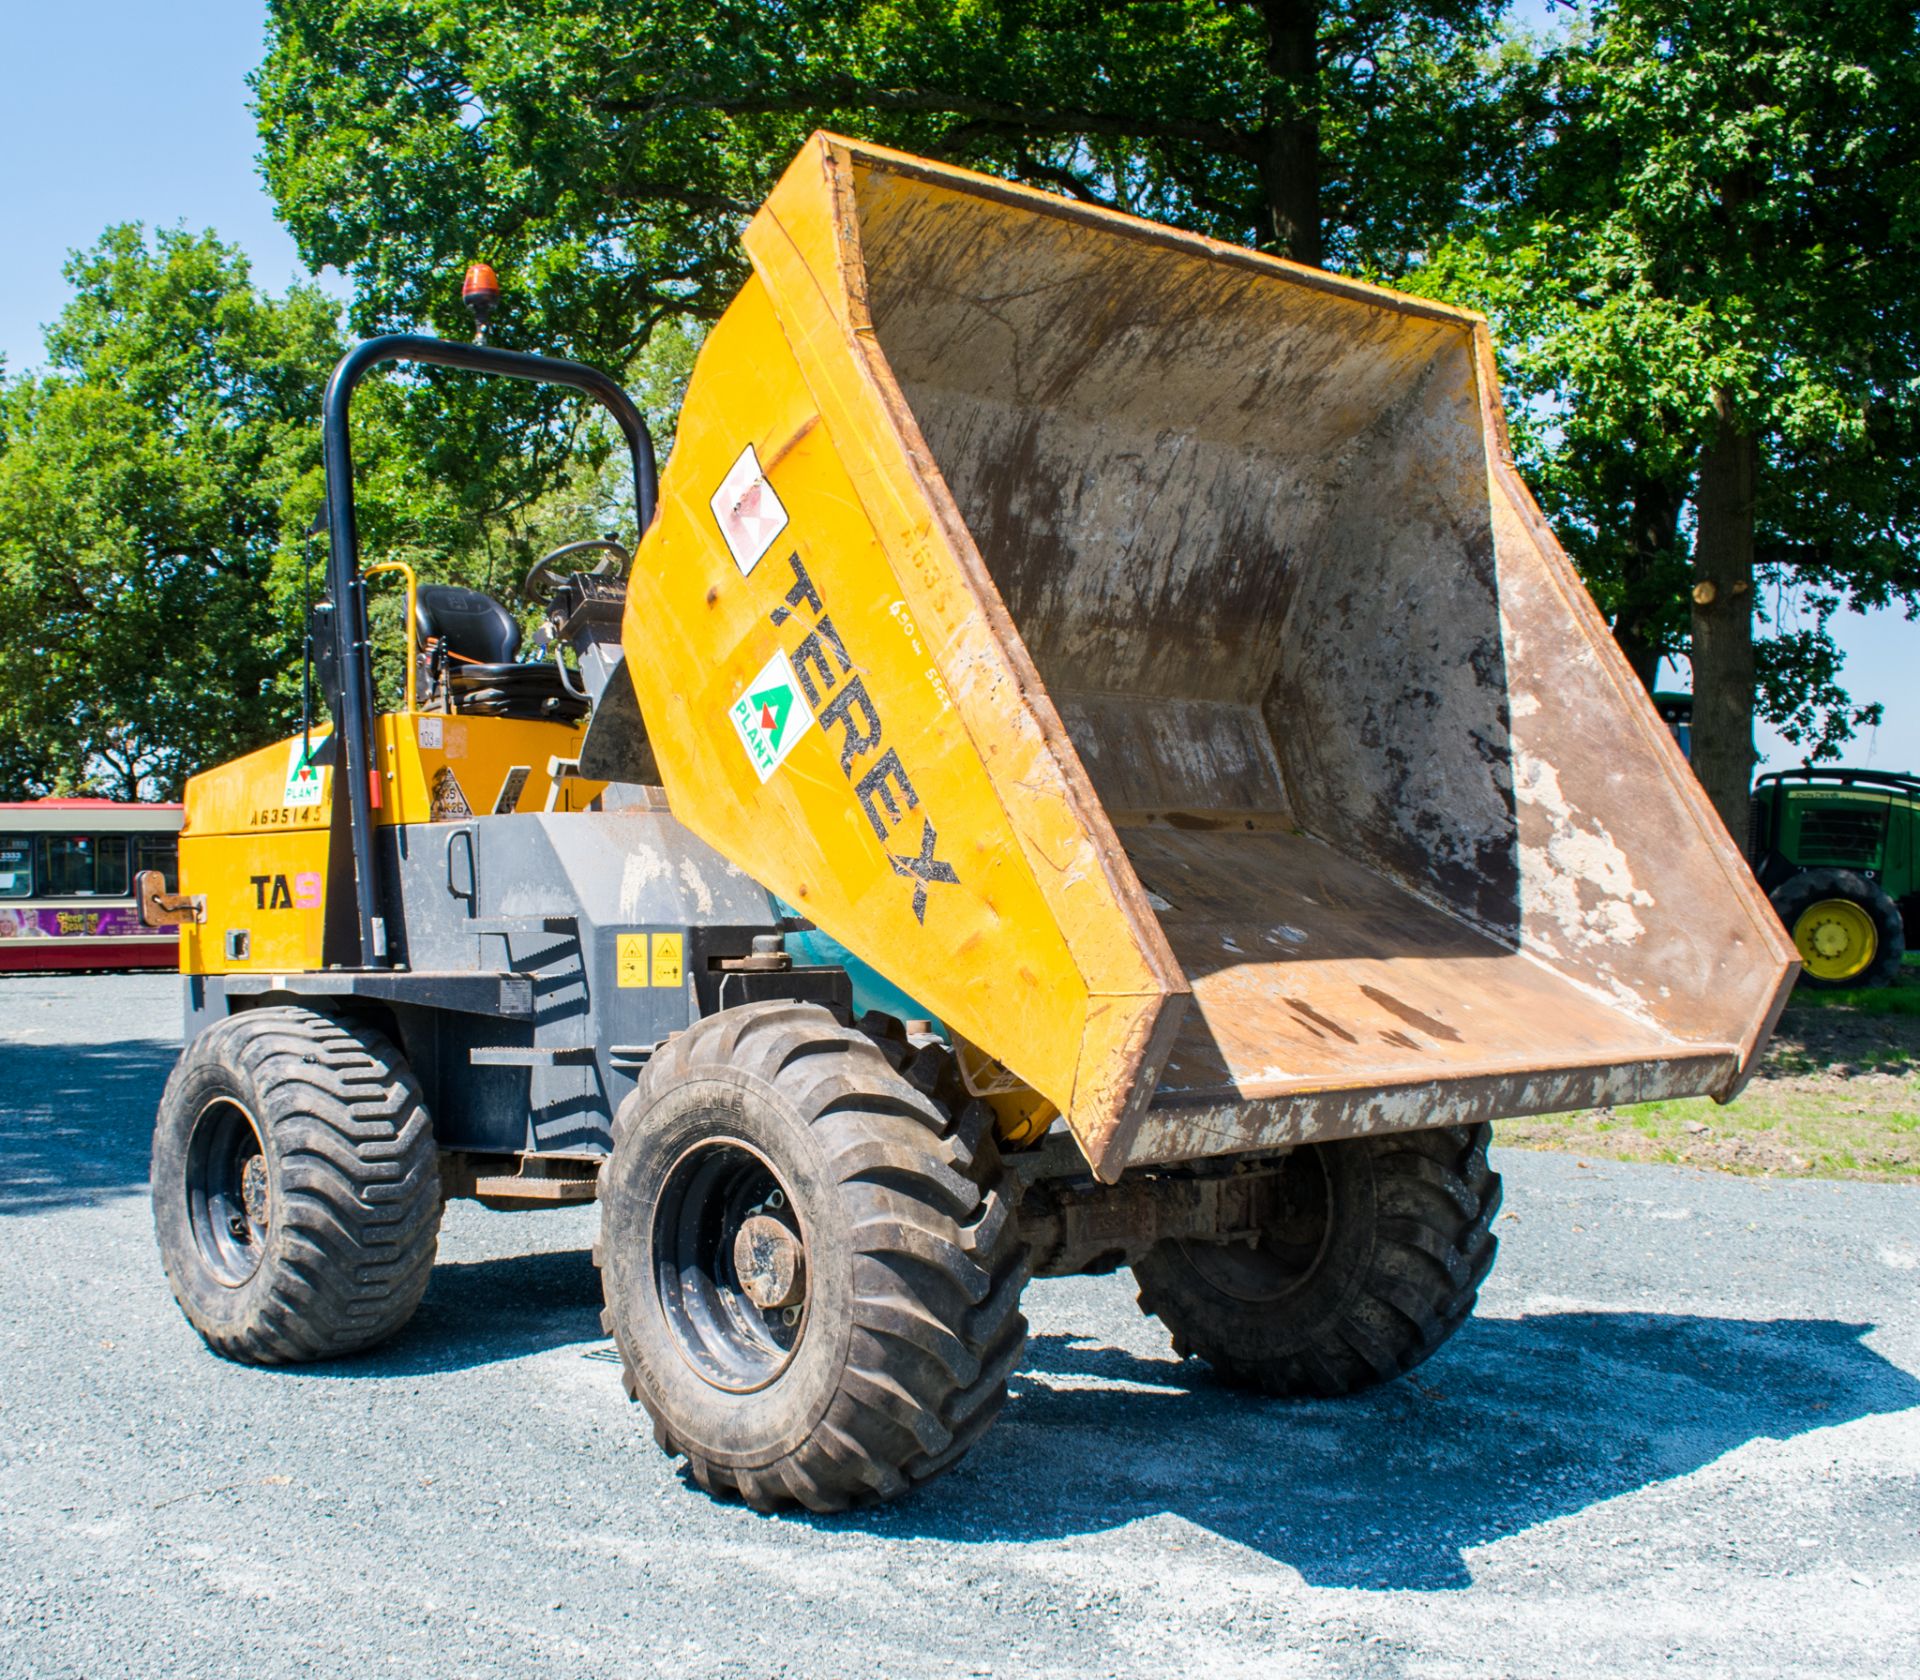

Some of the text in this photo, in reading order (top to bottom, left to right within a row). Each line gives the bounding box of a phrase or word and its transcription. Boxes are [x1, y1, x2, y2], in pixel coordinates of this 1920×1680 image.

[734, 698, 775, 770] PLANT
[748, 683, 795, 754] A
[769, 549, 962, 928] TEREX
[286, 784, 319, 799] PLANT
[250, 806, 322, 826] A635145
[249, 872, 322, 910] TA9
[56, 911, 98, 924] Sleepng
